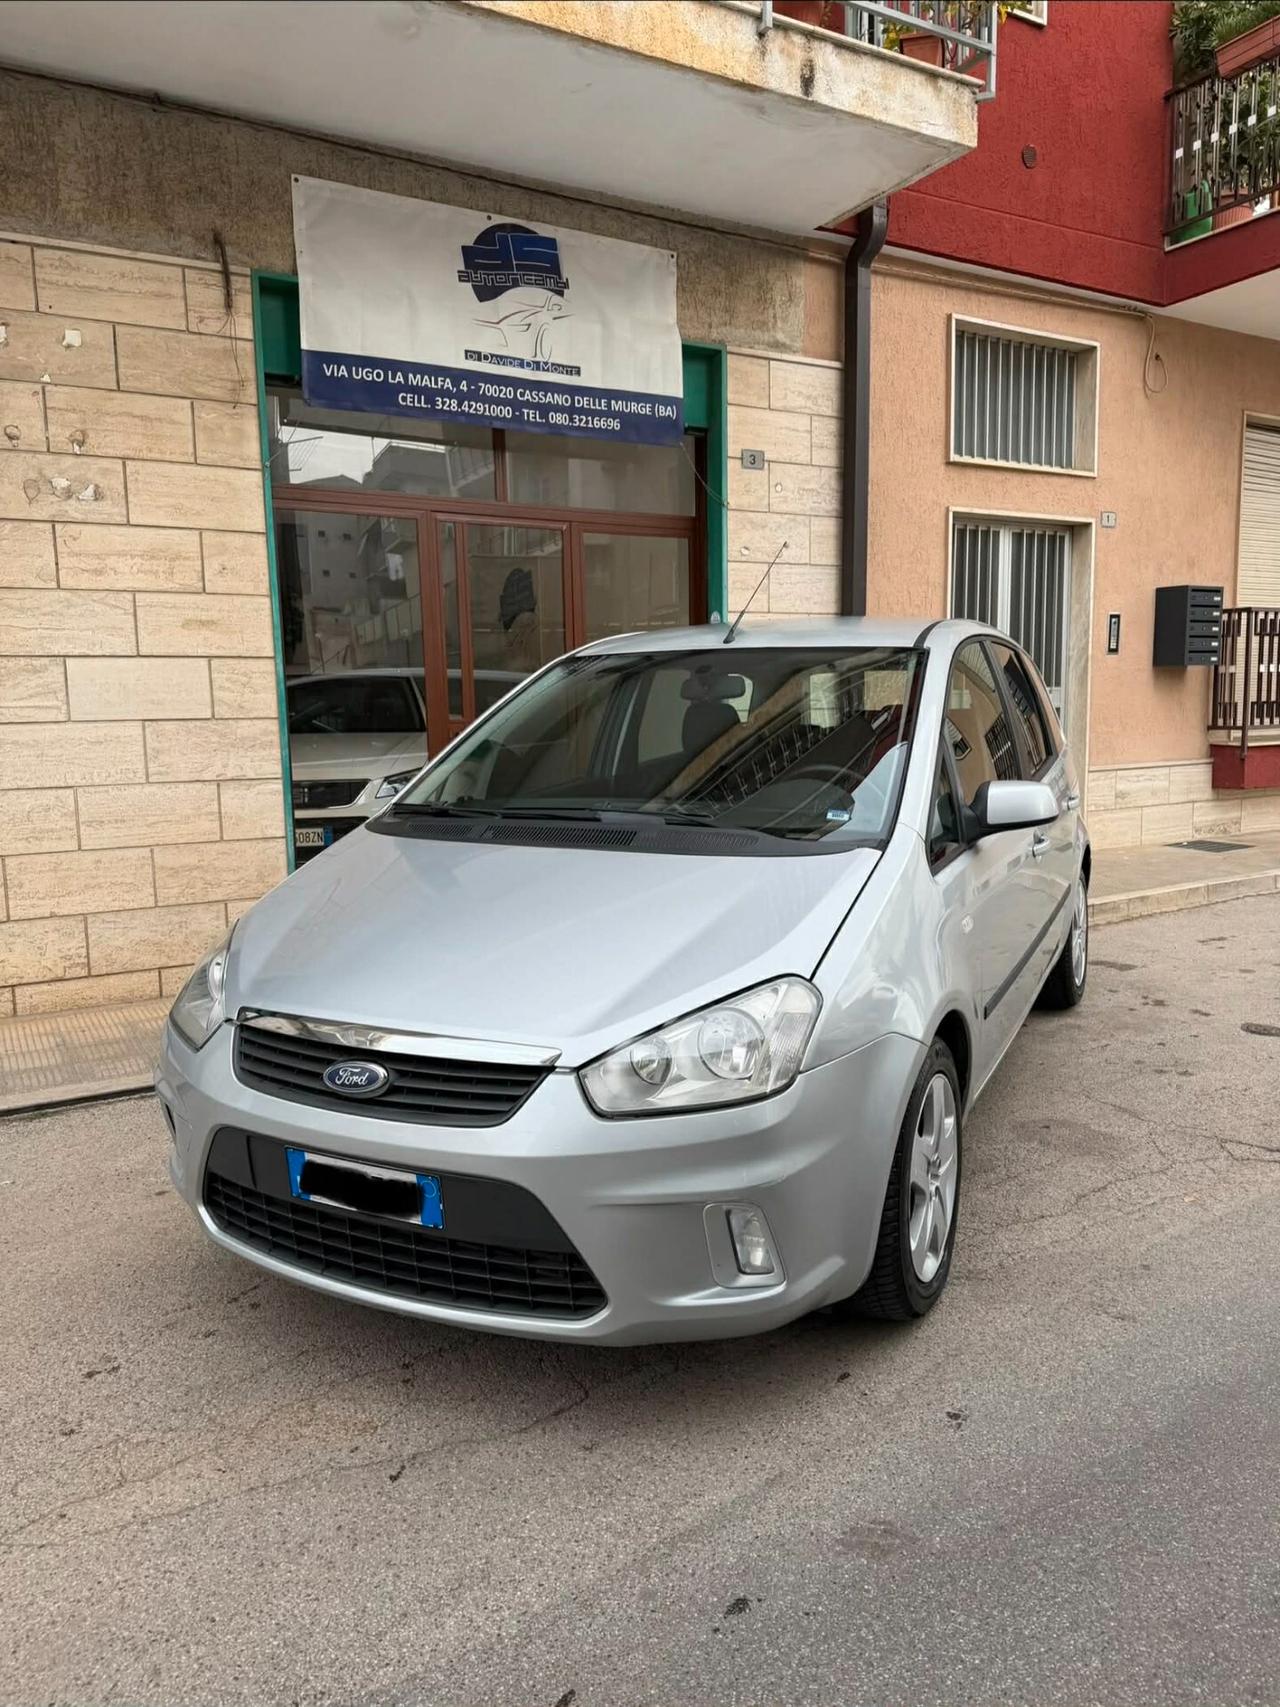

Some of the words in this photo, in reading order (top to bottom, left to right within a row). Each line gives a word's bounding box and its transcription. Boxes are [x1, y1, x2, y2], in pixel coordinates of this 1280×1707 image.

[322, 363, 348, 378] VIA
[352, 366, 384, 382] UGO
[388, 371, 404, 385] LA
[408, 374, 457, 393] MALFA,
[459, 380, 468, 392] 4
[478, 382, 514, 399] 70020
[516, 388, 571, 407] CASSANO
[574, 395, 608, 411] DELLE
[611, 400, 652, 415] MURGE
[655, 403, 677, 421] (BA)
[398, 393, 431, 408] CELL.
[435, 397, 512, 418] 328.4291000
[522, 408, 546, 423] TEL.
[549, 411, 621, 430] 080.3216696
[749, 454, 756, 465] 3
[335, 1067, 369, 1085] Ford
